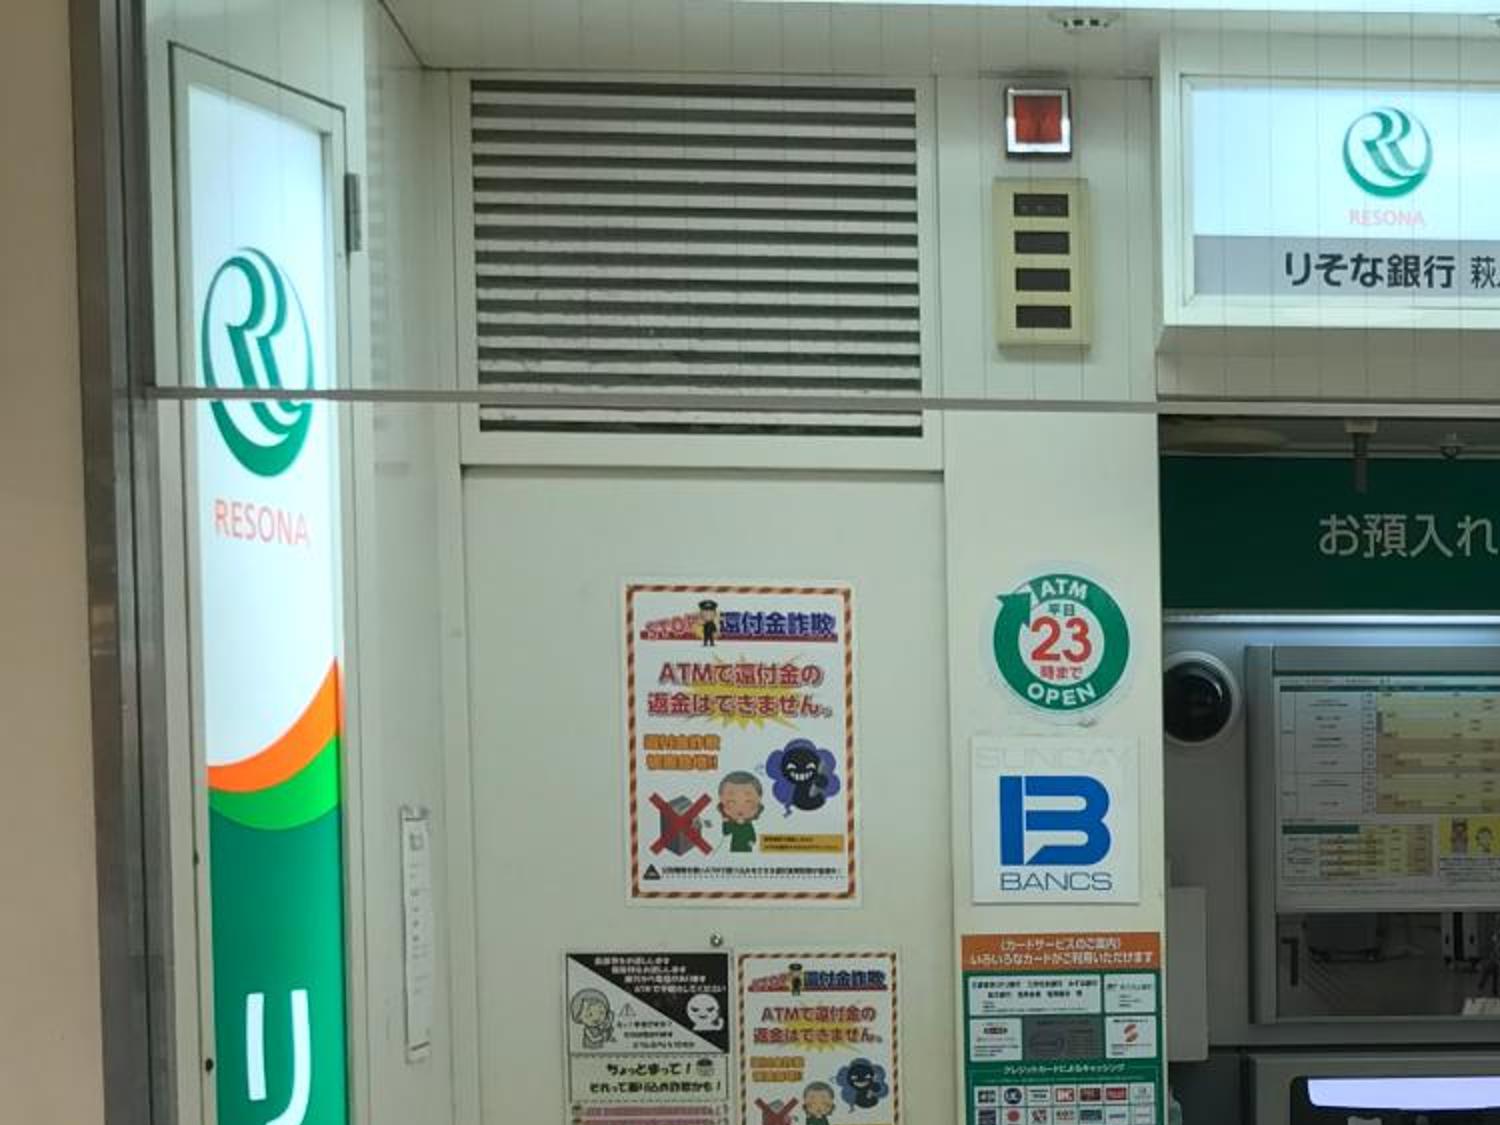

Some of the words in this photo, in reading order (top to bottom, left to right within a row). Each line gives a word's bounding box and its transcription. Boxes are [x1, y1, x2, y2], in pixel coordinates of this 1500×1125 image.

[1349, 209, 1425, 227] RESONA
[1284, 252, 1455, 288] りそな銀行
[213, 498, 312, 547] RESONA
[1041, 578, 1089, 600] ATM
[1048, 603, 1075, 616] 平日
[1030, 615, 1092, 663] 23
[658, 661, 825, 688] ATMで還付金の
[1040, 666, 1084, 680] 時まで
[1027, 682, 1097, 706] OPEN
[999, 870, 1114, 892] BANCS
